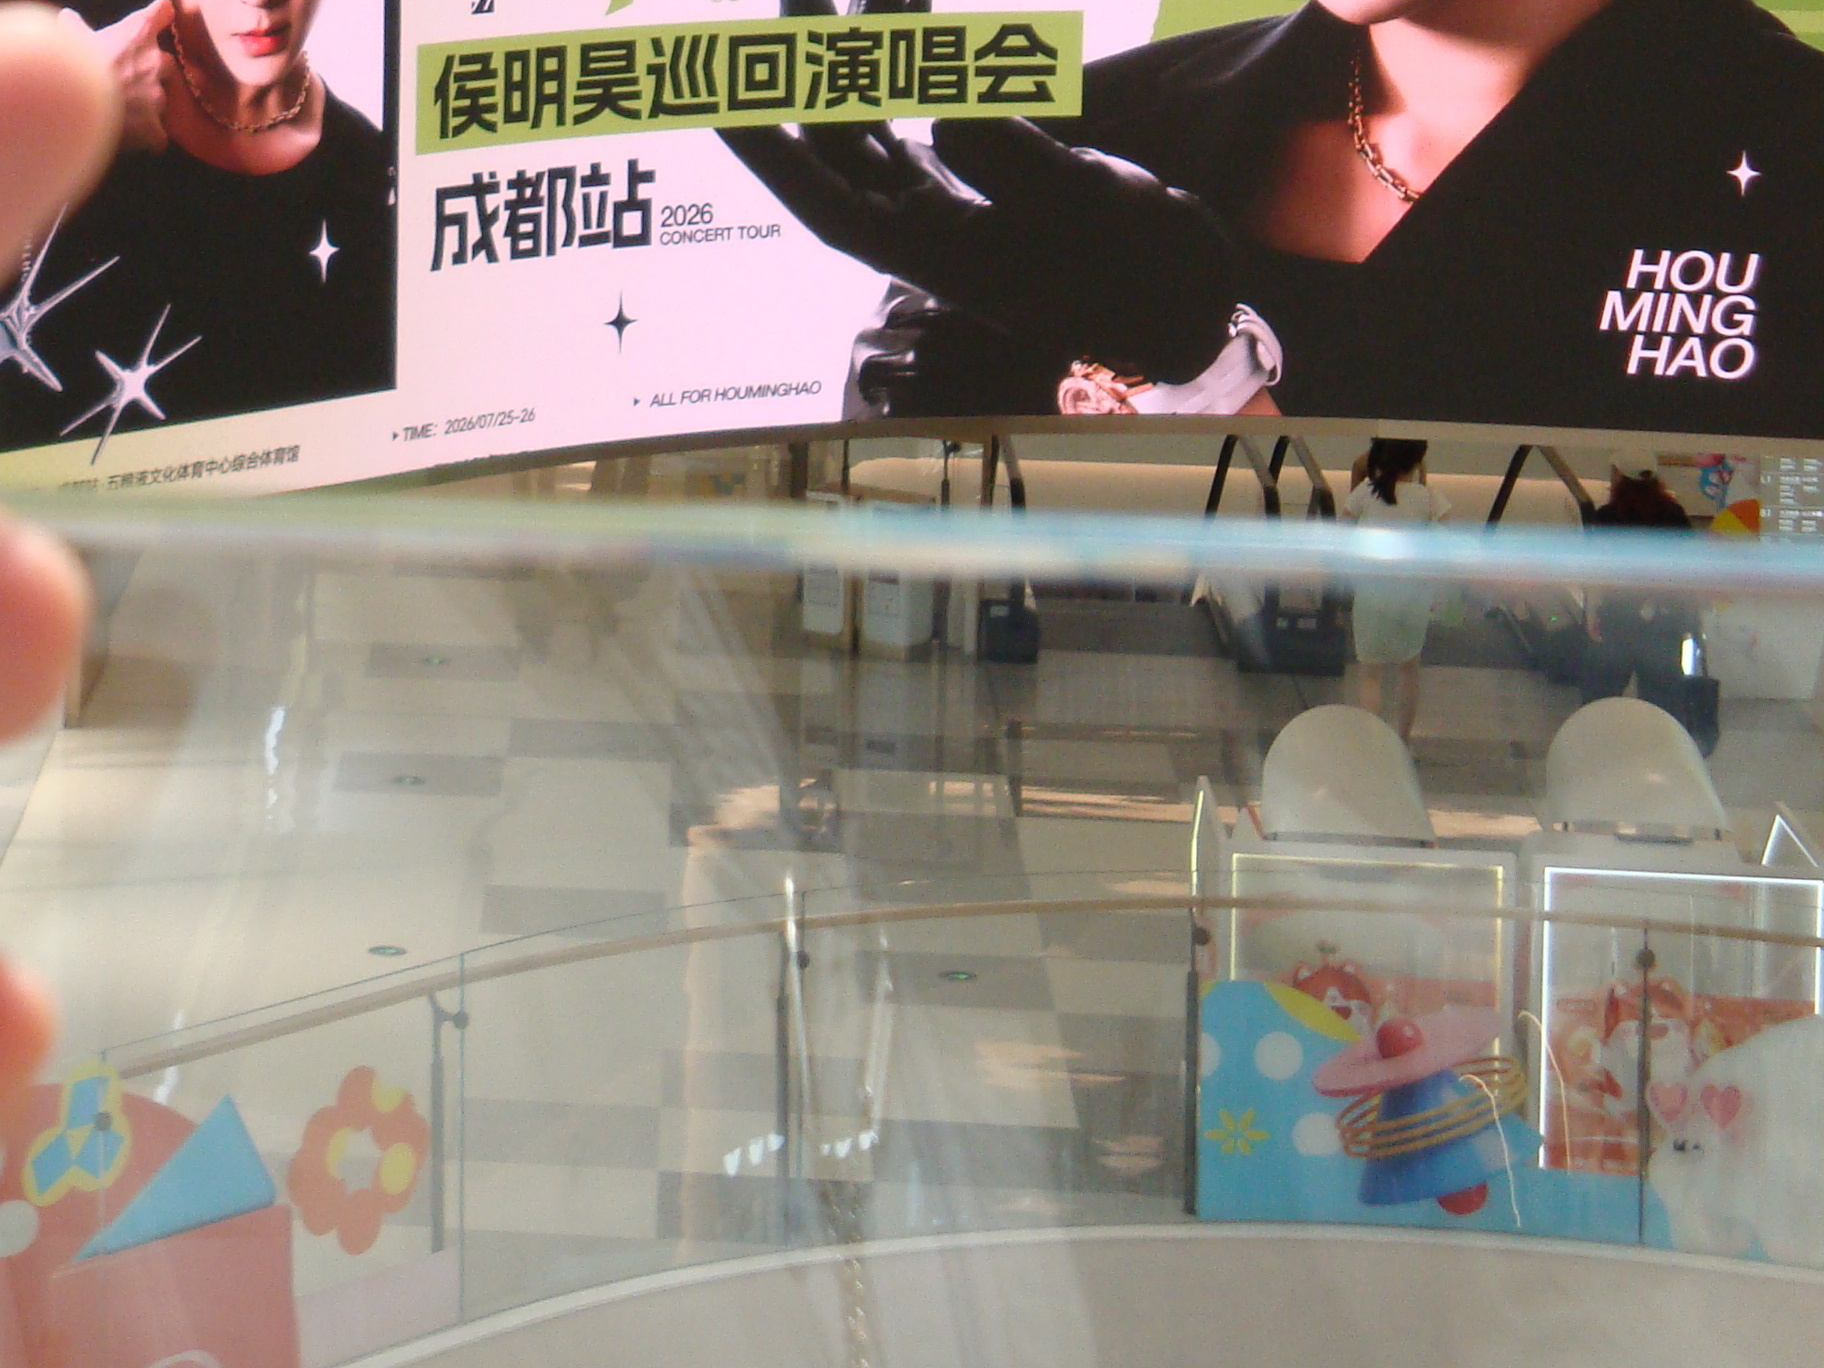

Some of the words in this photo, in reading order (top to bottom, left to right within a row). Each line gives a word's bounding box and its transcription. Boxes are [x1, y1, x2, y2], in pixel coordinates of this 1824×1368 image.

[433, 22, 1059, 140] 侯明昊巡回演唱会
[431, 158, 656, 273] 成都站
[659, 226, 734, 247] CONCERT
[738, 224, 782, 242] TOUR
[661, 203, 714, 229] 2026
[1626, 248, 1760, 293] HOU
[1599, 290, 1758, 337] MING
[1627, 334, 1757, 381] HAO
[650, 390, 677, 409] ALL
[680, 388, 711, 406] FOR
[714, 380, 823, 404] HOUMINGHAO
[403, 423, 438, 442] TIME:
[444, 408, 536, 436] 2026/07/25-26
